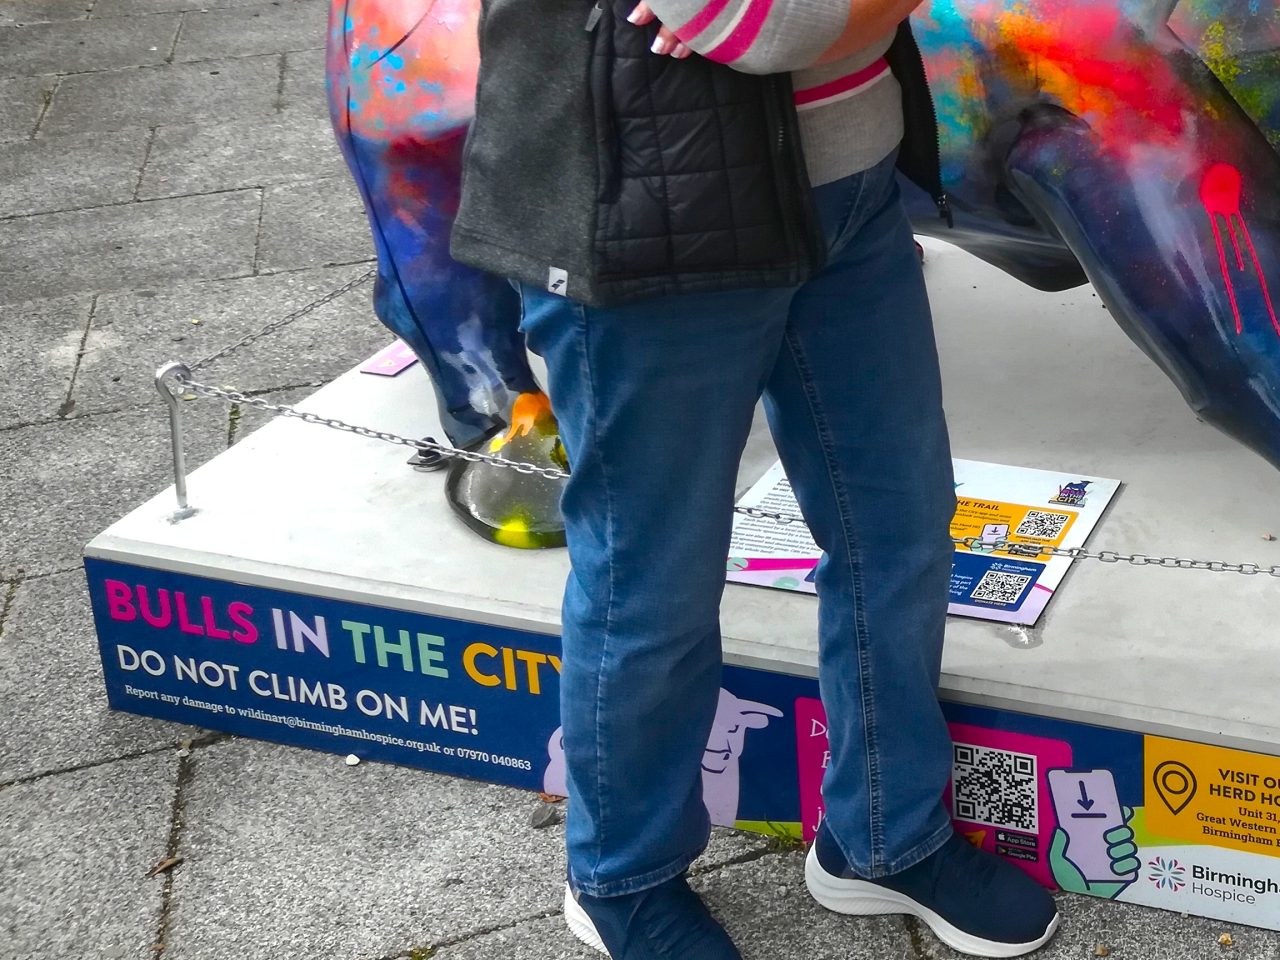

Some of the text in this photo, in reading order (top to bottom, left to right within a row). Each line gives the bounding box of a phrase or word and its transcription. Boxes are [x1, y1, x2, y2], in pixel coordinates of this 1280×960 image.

[973, 502, 1000, 511] TRAIL
[1003, 564, 1037, 572] Birmingham
[105, 578, 259, 645] BULLS
[272, 608, 330, 658] IN
[341, 620, 449, 679] THE
[117, 644, 479, 736] DO NOT CLIMB ON ME!
[125, 684, 532, 771] Report any damage to wildinart@birminghamhospice.org.uk or 07970 040863
[1218, 768, 1259, 787] VISIT
[1209, 783, 1256, 802] HERD
[1196, 812, 1226, 825] Great
[1229, 817, 1276, 834] Western
[1238, 807, 1280, 824] Unit 31,
[1202, 825, 1273, 846] Birmingham
[1192, 882, 1256, 905] Hospice
